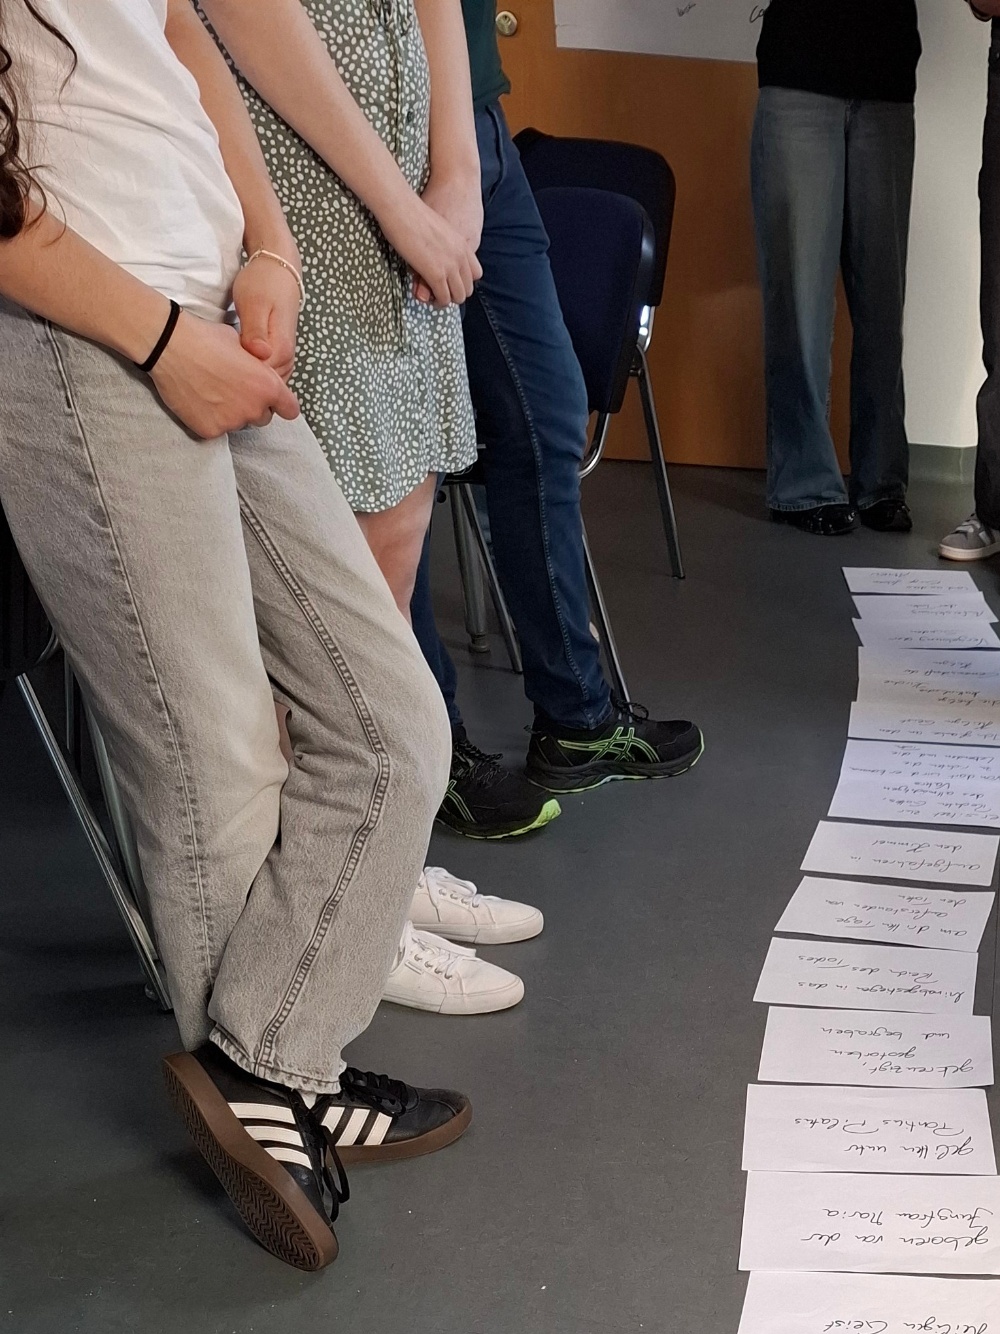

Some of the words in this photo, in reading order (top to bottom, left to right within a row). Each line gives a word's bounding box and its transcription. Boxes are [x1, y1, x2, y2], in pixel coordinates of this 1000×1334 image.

[872, 840, 930, 853] Himmel
[934, 844, 962, 853] den
[872, 859, 980, 872] aufgefahren
[897, 895, 932, 905] Toten
[939, 898, 966, 907] den
[854, 904, 948, 919] auferstanden
[834, 916, 874, 928] Tage
[882, 922, 929, 935] dritten
[940, 928, 967, 937] am
[798, 955, 849, 968] Todes
[852, 966, 880, 976] des
[889, 969, 938, 984] Reich
[797, 982, 828, 990] das
[821, 1027, 902, 1040] begraben
[921, 1032, 950, 1040] und
[828, 1046, 916, 1059] gestorben
[794, 1118, 879, 1134] Pilatus
[882, 1119, 964, 1137] Pontius
[843, 1145, 886, 1155] unter
[900, 1136, 973, 1160] gelitten
[822, 1209, 883, 1225] Maria
[895, 1208, 993, 1228] Jungfrau
[801, 1232, 841, 1246] der
[854, 1234, 883, 1242] von
[899, 1226, 988, 1251] geboren
